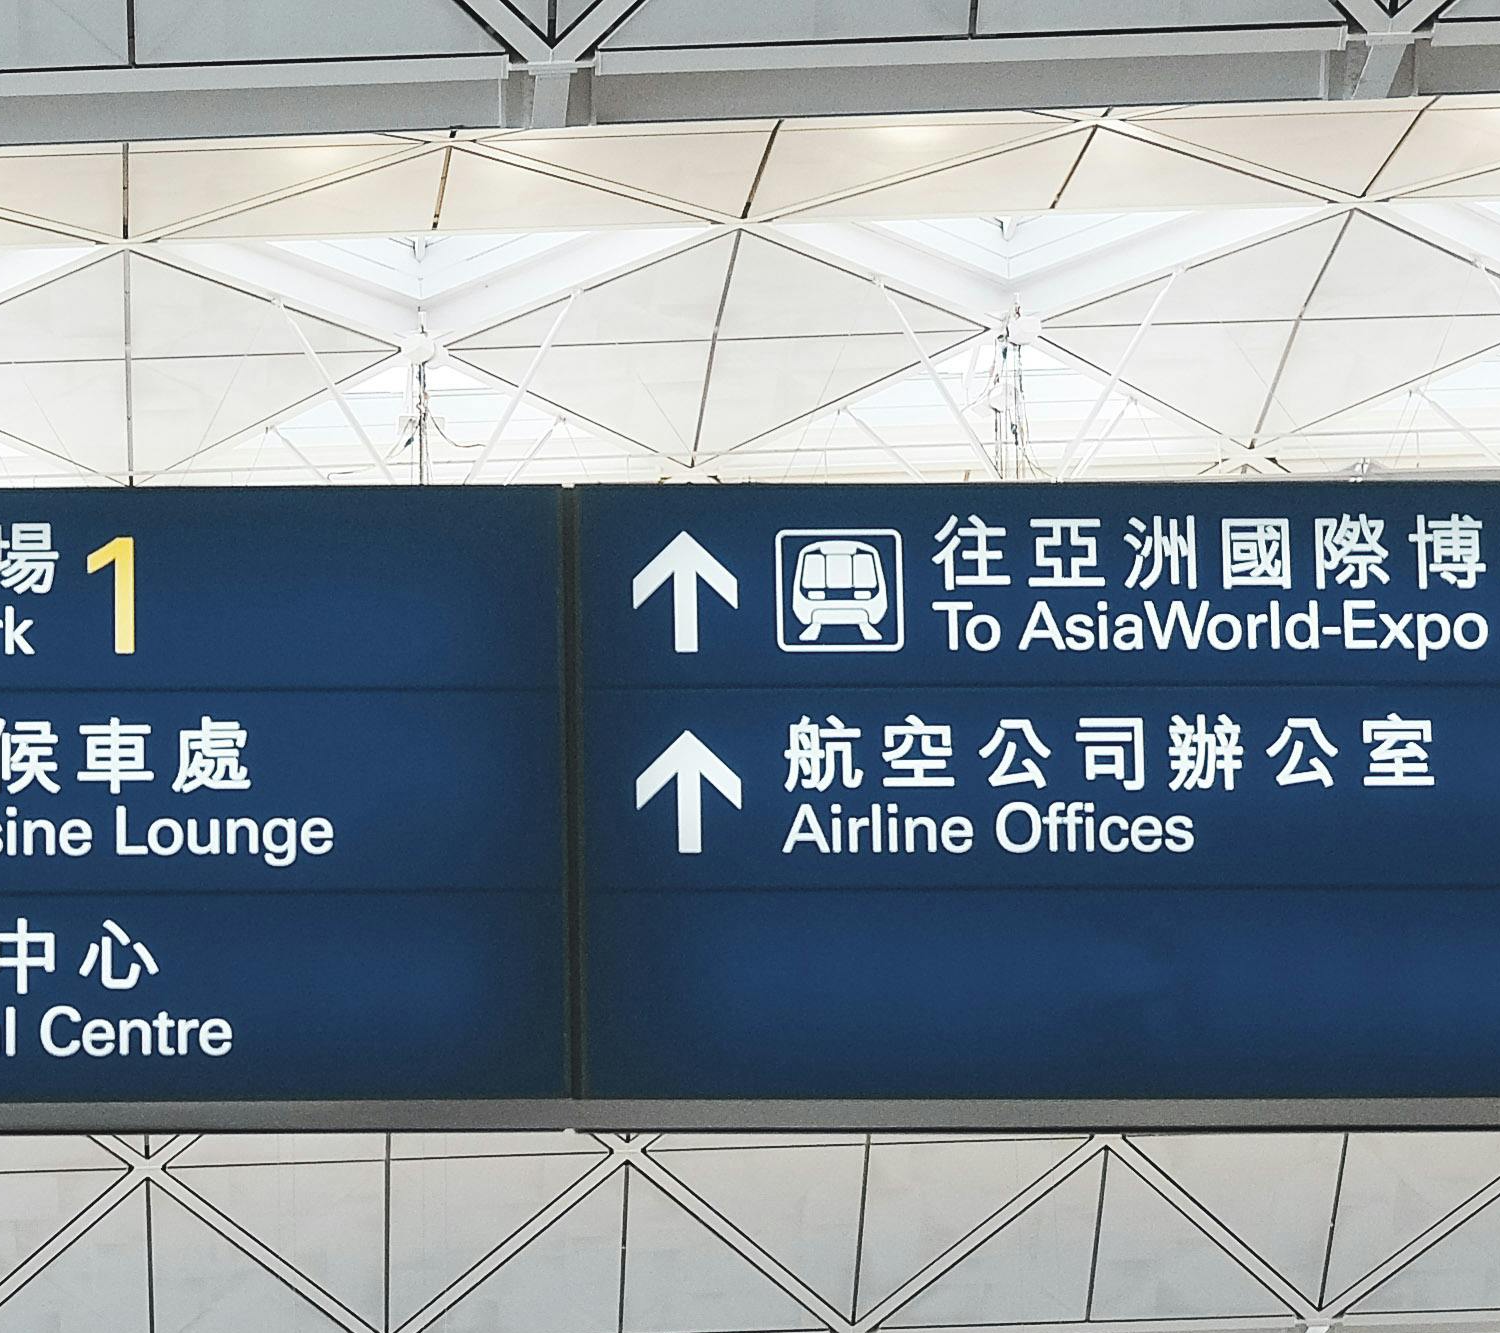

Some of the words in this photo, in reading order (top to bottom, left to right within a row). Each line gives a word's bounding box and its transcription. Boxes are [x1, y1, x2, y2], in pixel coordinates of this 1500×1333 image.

[86, 536, 136, 655] 1
[931, 601, 1001, 652] To
[1018, 599, 1489, 661] AsiaWorld-Expo
[783, 712, 1436, 794] 航空公司辦公室
[115, 805, 334, 867] Lounge
[782, 803, 974, 854] Airline
[995, 801, 1195, 854] Offices
[40, 1005, 233, 1057] Centre
